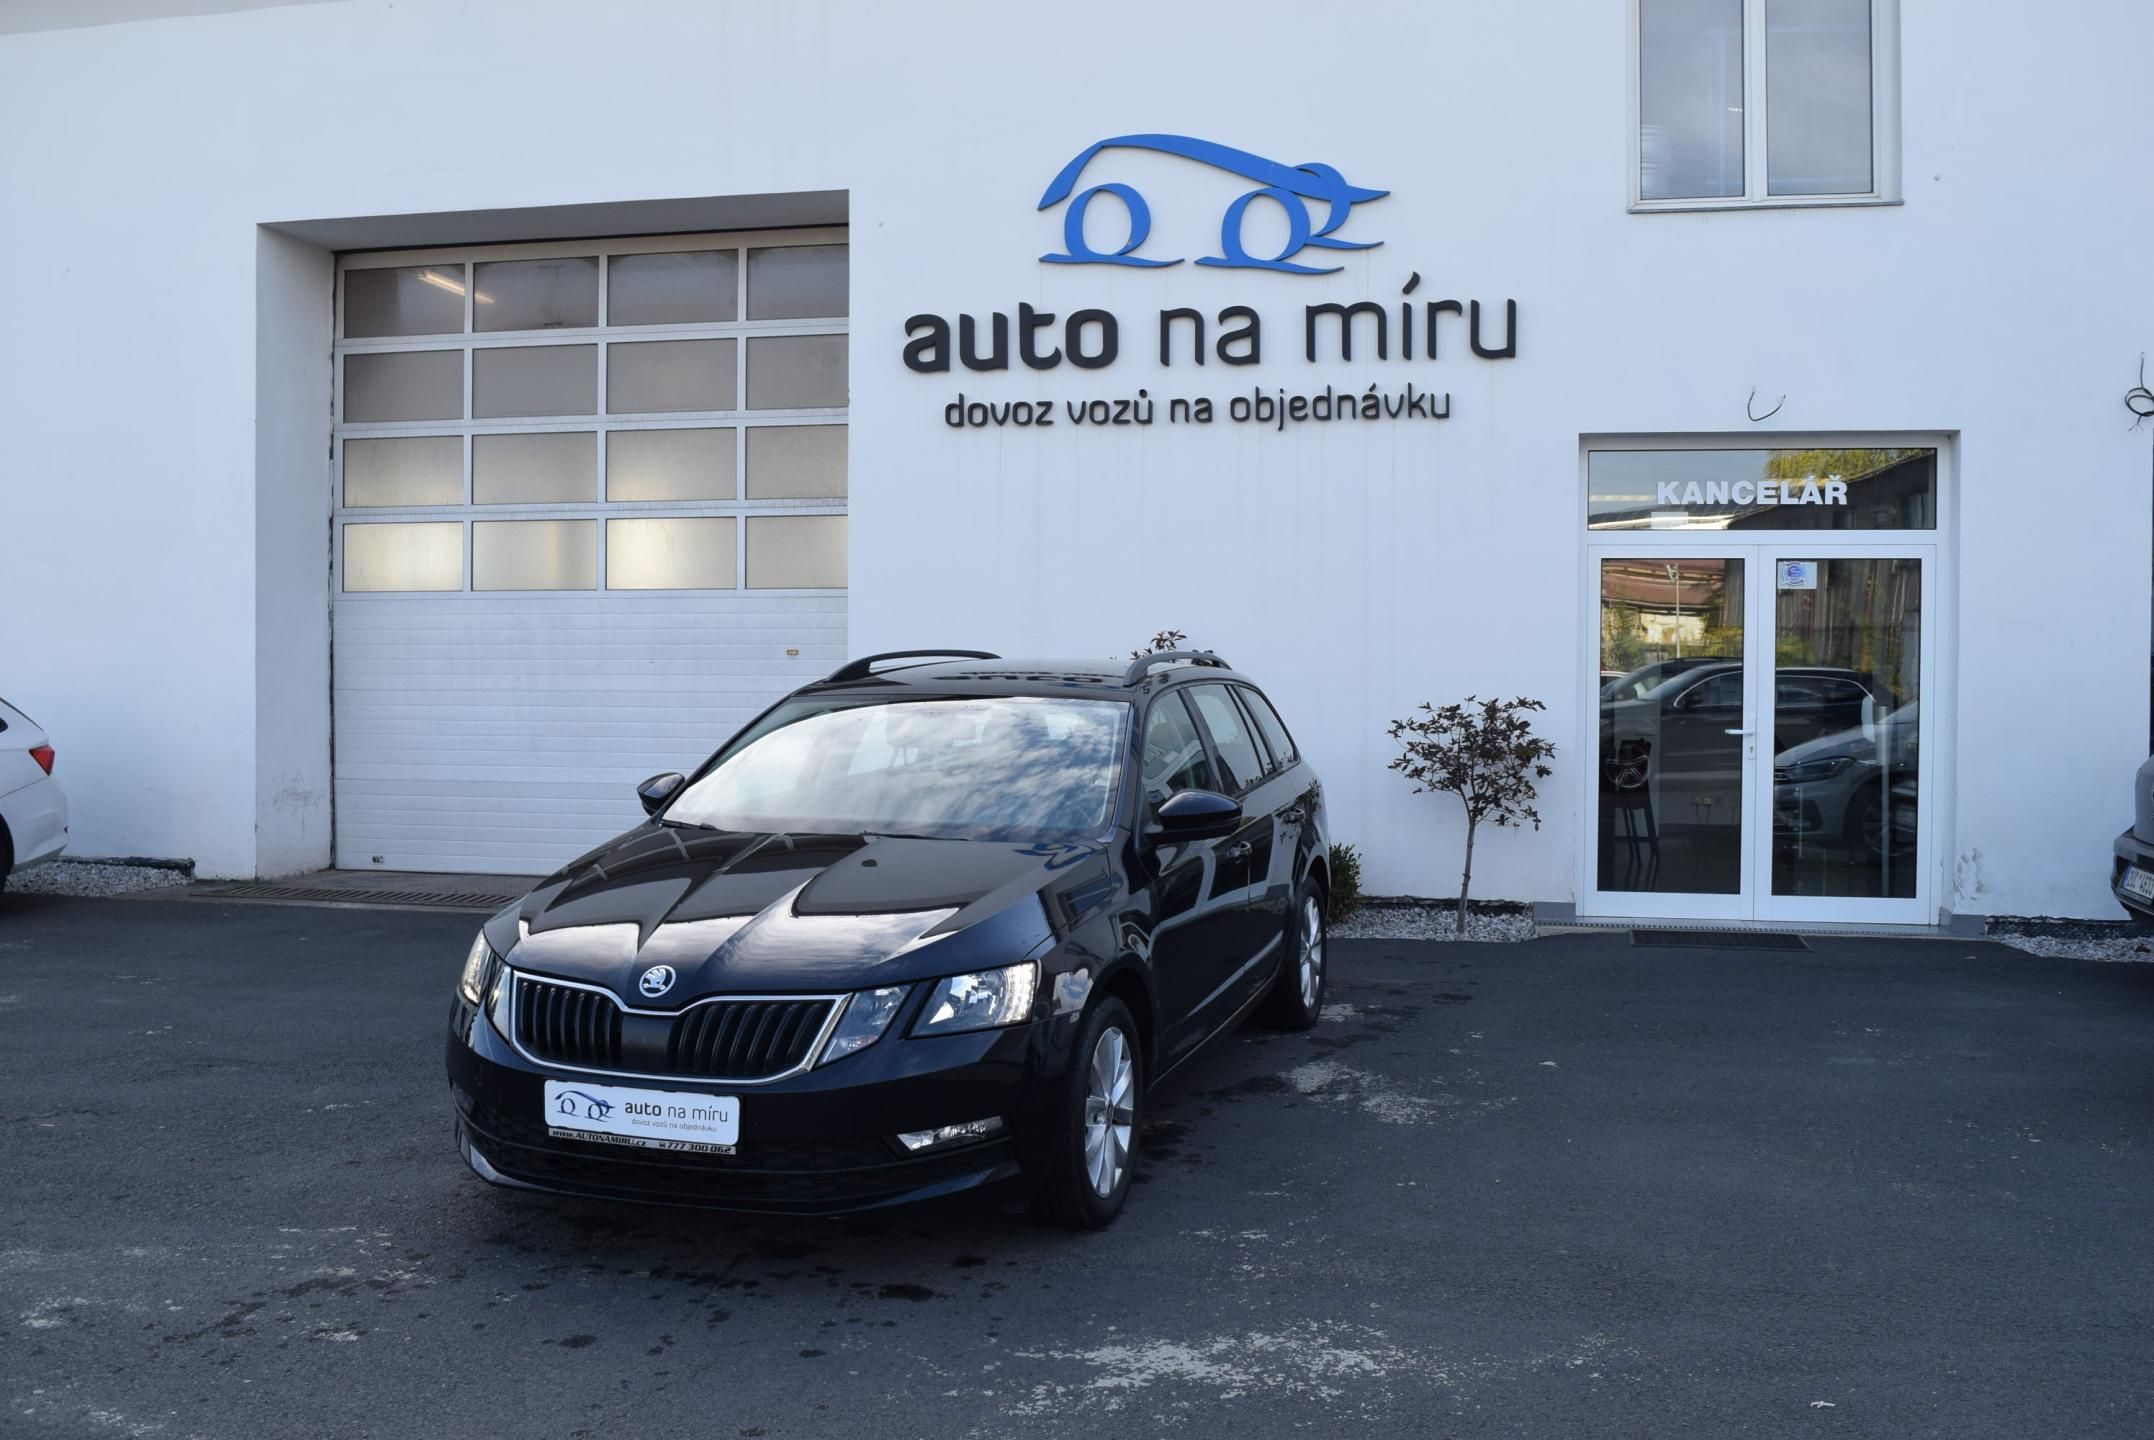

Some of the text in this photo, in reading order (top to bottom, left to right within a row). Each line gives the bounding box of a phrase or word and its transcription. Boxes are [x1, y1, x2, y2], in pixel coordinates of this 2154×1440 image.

[902, 271, 1517, 374] auto na míru
[945, 382, 1451, 432] dovoz vozů na objednávku
[1656, 475, 1848, 505] KANCELÁŘ
[624, 1102, 728, 1122] auto na míru
[631, 1118, 651, 1127] dovoz
[652, 1120, 668, 1128] vozů
[667, 1141, 686, 1150] 777
[687, 1143, 708, 1152] 300
